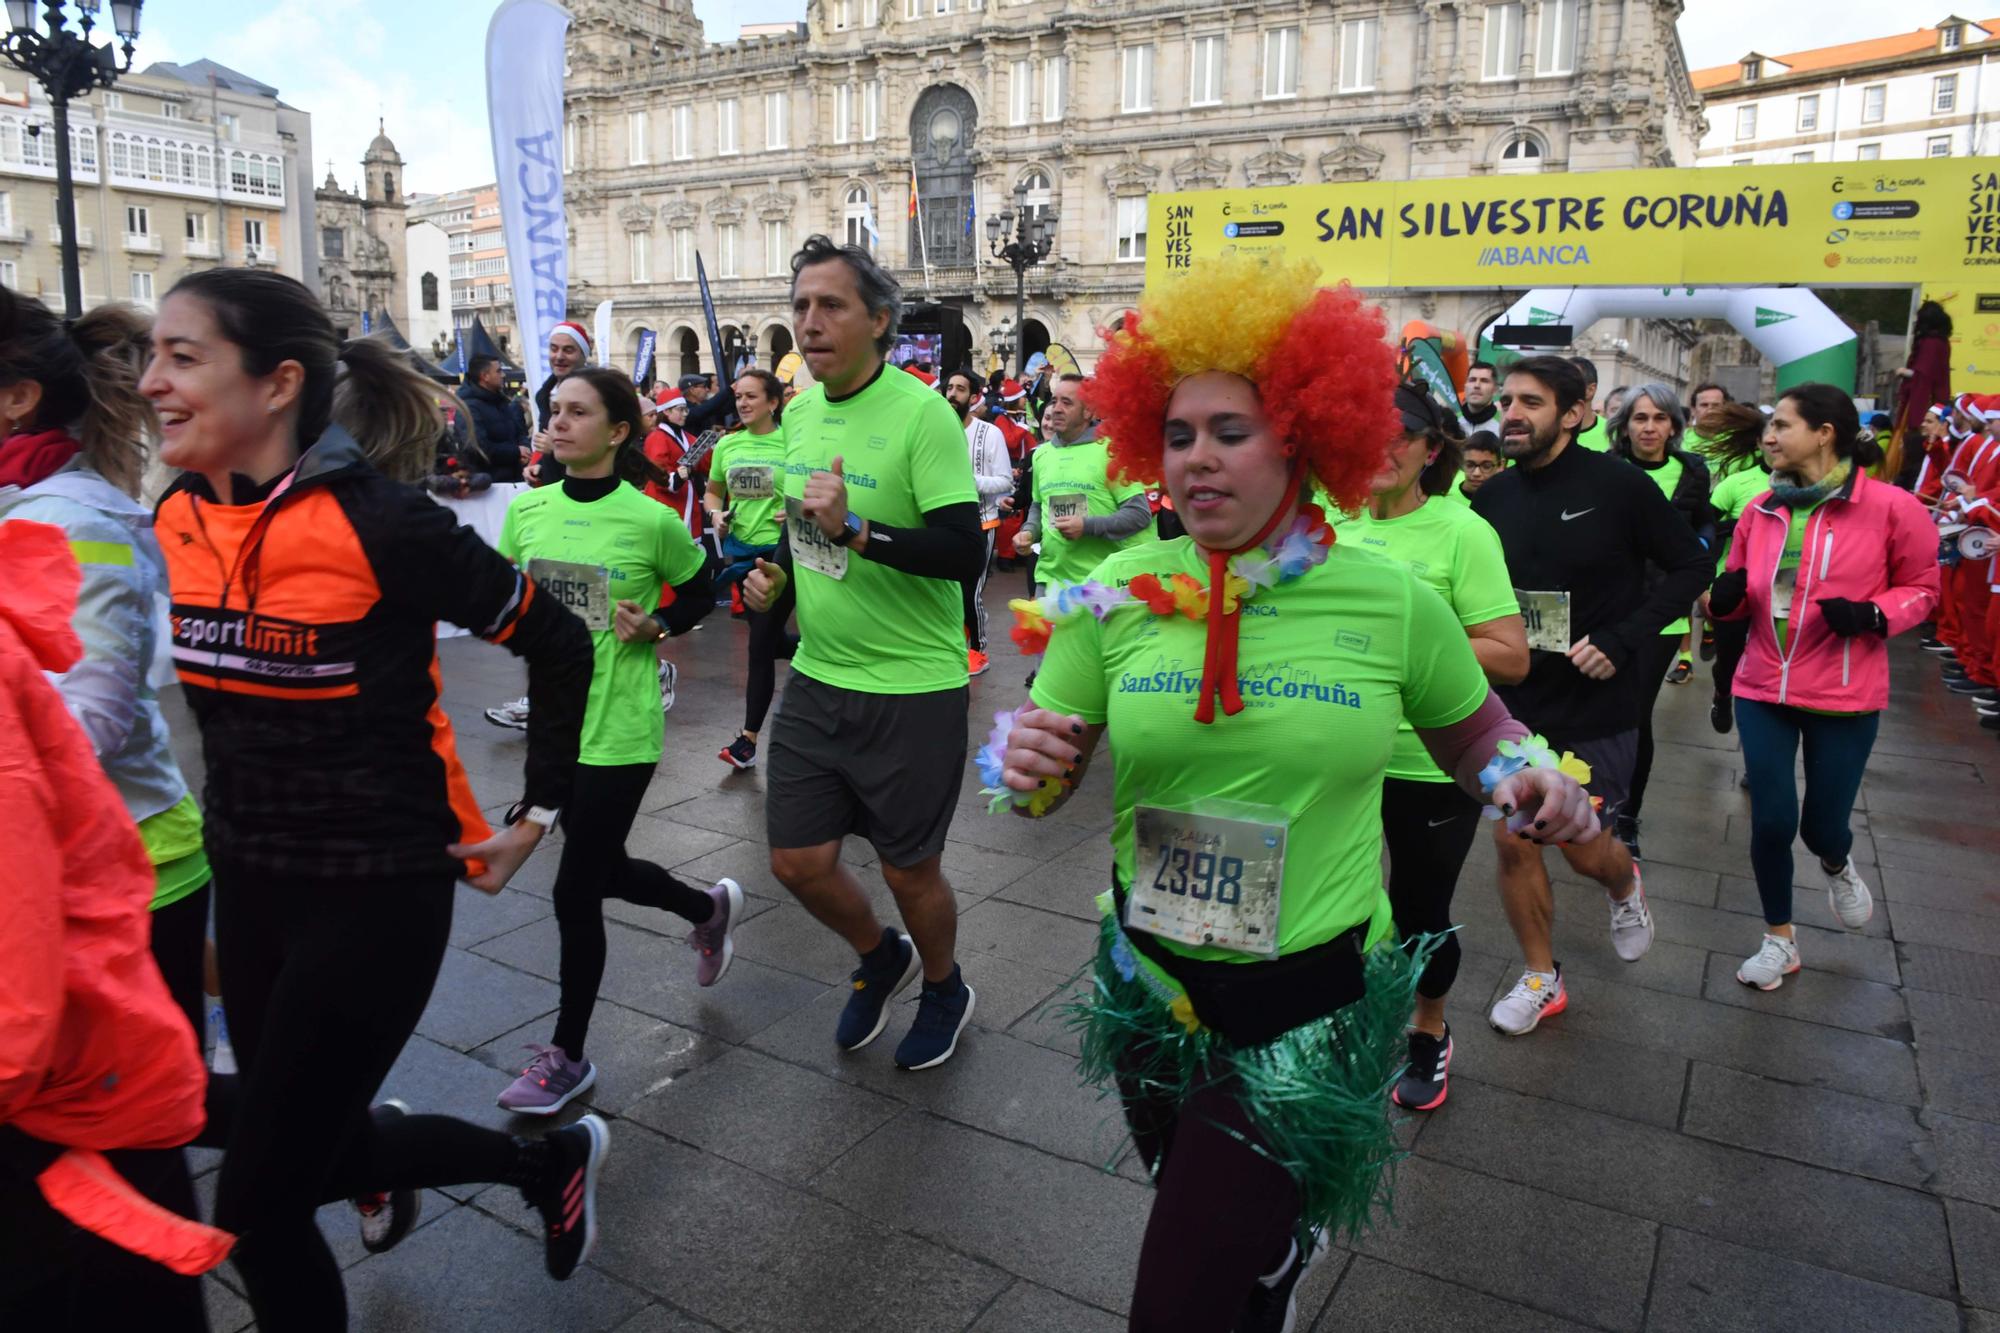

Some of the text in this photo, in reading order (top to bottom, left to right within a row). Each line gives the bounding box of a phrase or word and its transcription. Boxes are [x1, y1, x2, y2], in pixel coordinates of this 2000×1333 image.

[1972, 172, 2000, 191] SA
[1166, 205, 1193, 220] SAN
[1316, 185, 1788, 242] SAN SILVESTRE CORUÑA
[1166, 220, 1192, 238] SIL
[1166, 238, 1192, 253] VES
[1165, 253, 1191, 269] TRE
[740, 475, 761, 489] 970
[1053, 503, 1077, 518] 3917
[1153, 845, 1244, 905] 2398
